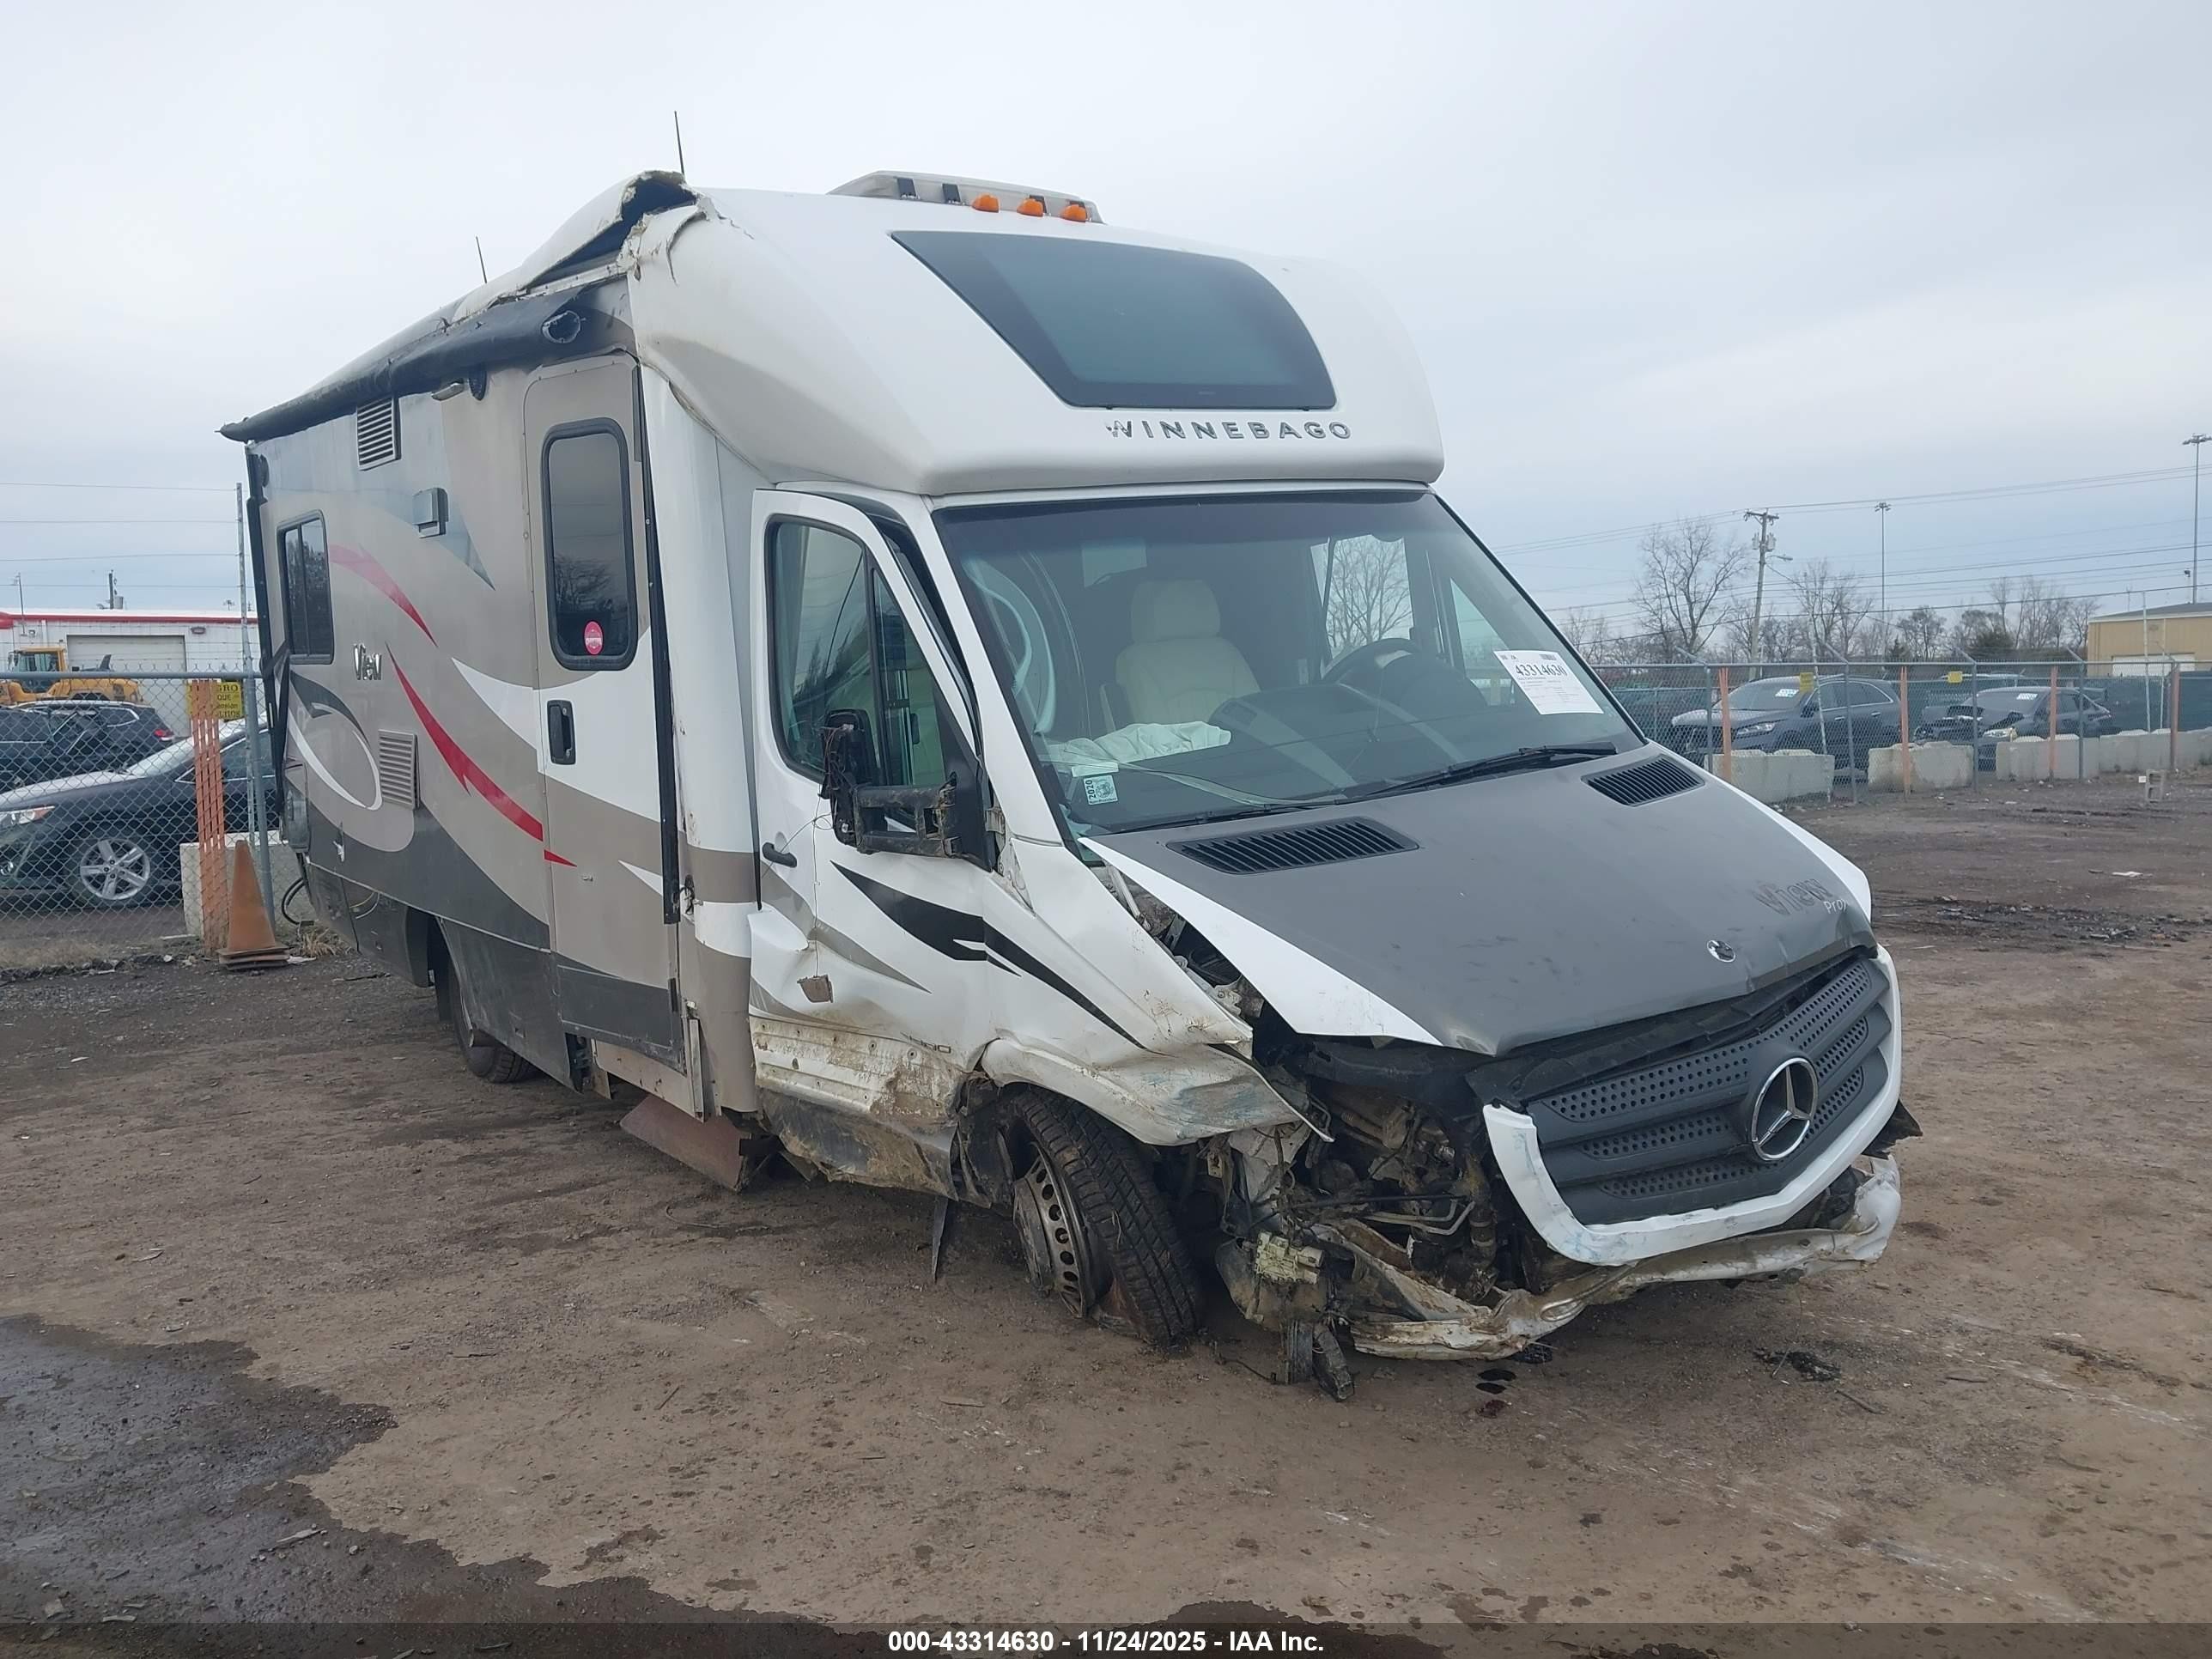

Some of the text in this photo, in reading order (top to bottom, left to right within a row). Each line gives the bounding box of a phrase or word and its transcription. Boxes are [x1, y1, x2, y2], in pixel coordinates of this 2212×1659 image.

[1105, 420, 1352, 439] WINNEBAGO
[1516, 664, 1568, 677] 43314630
[1085, 780, 1096, 800] 2020
